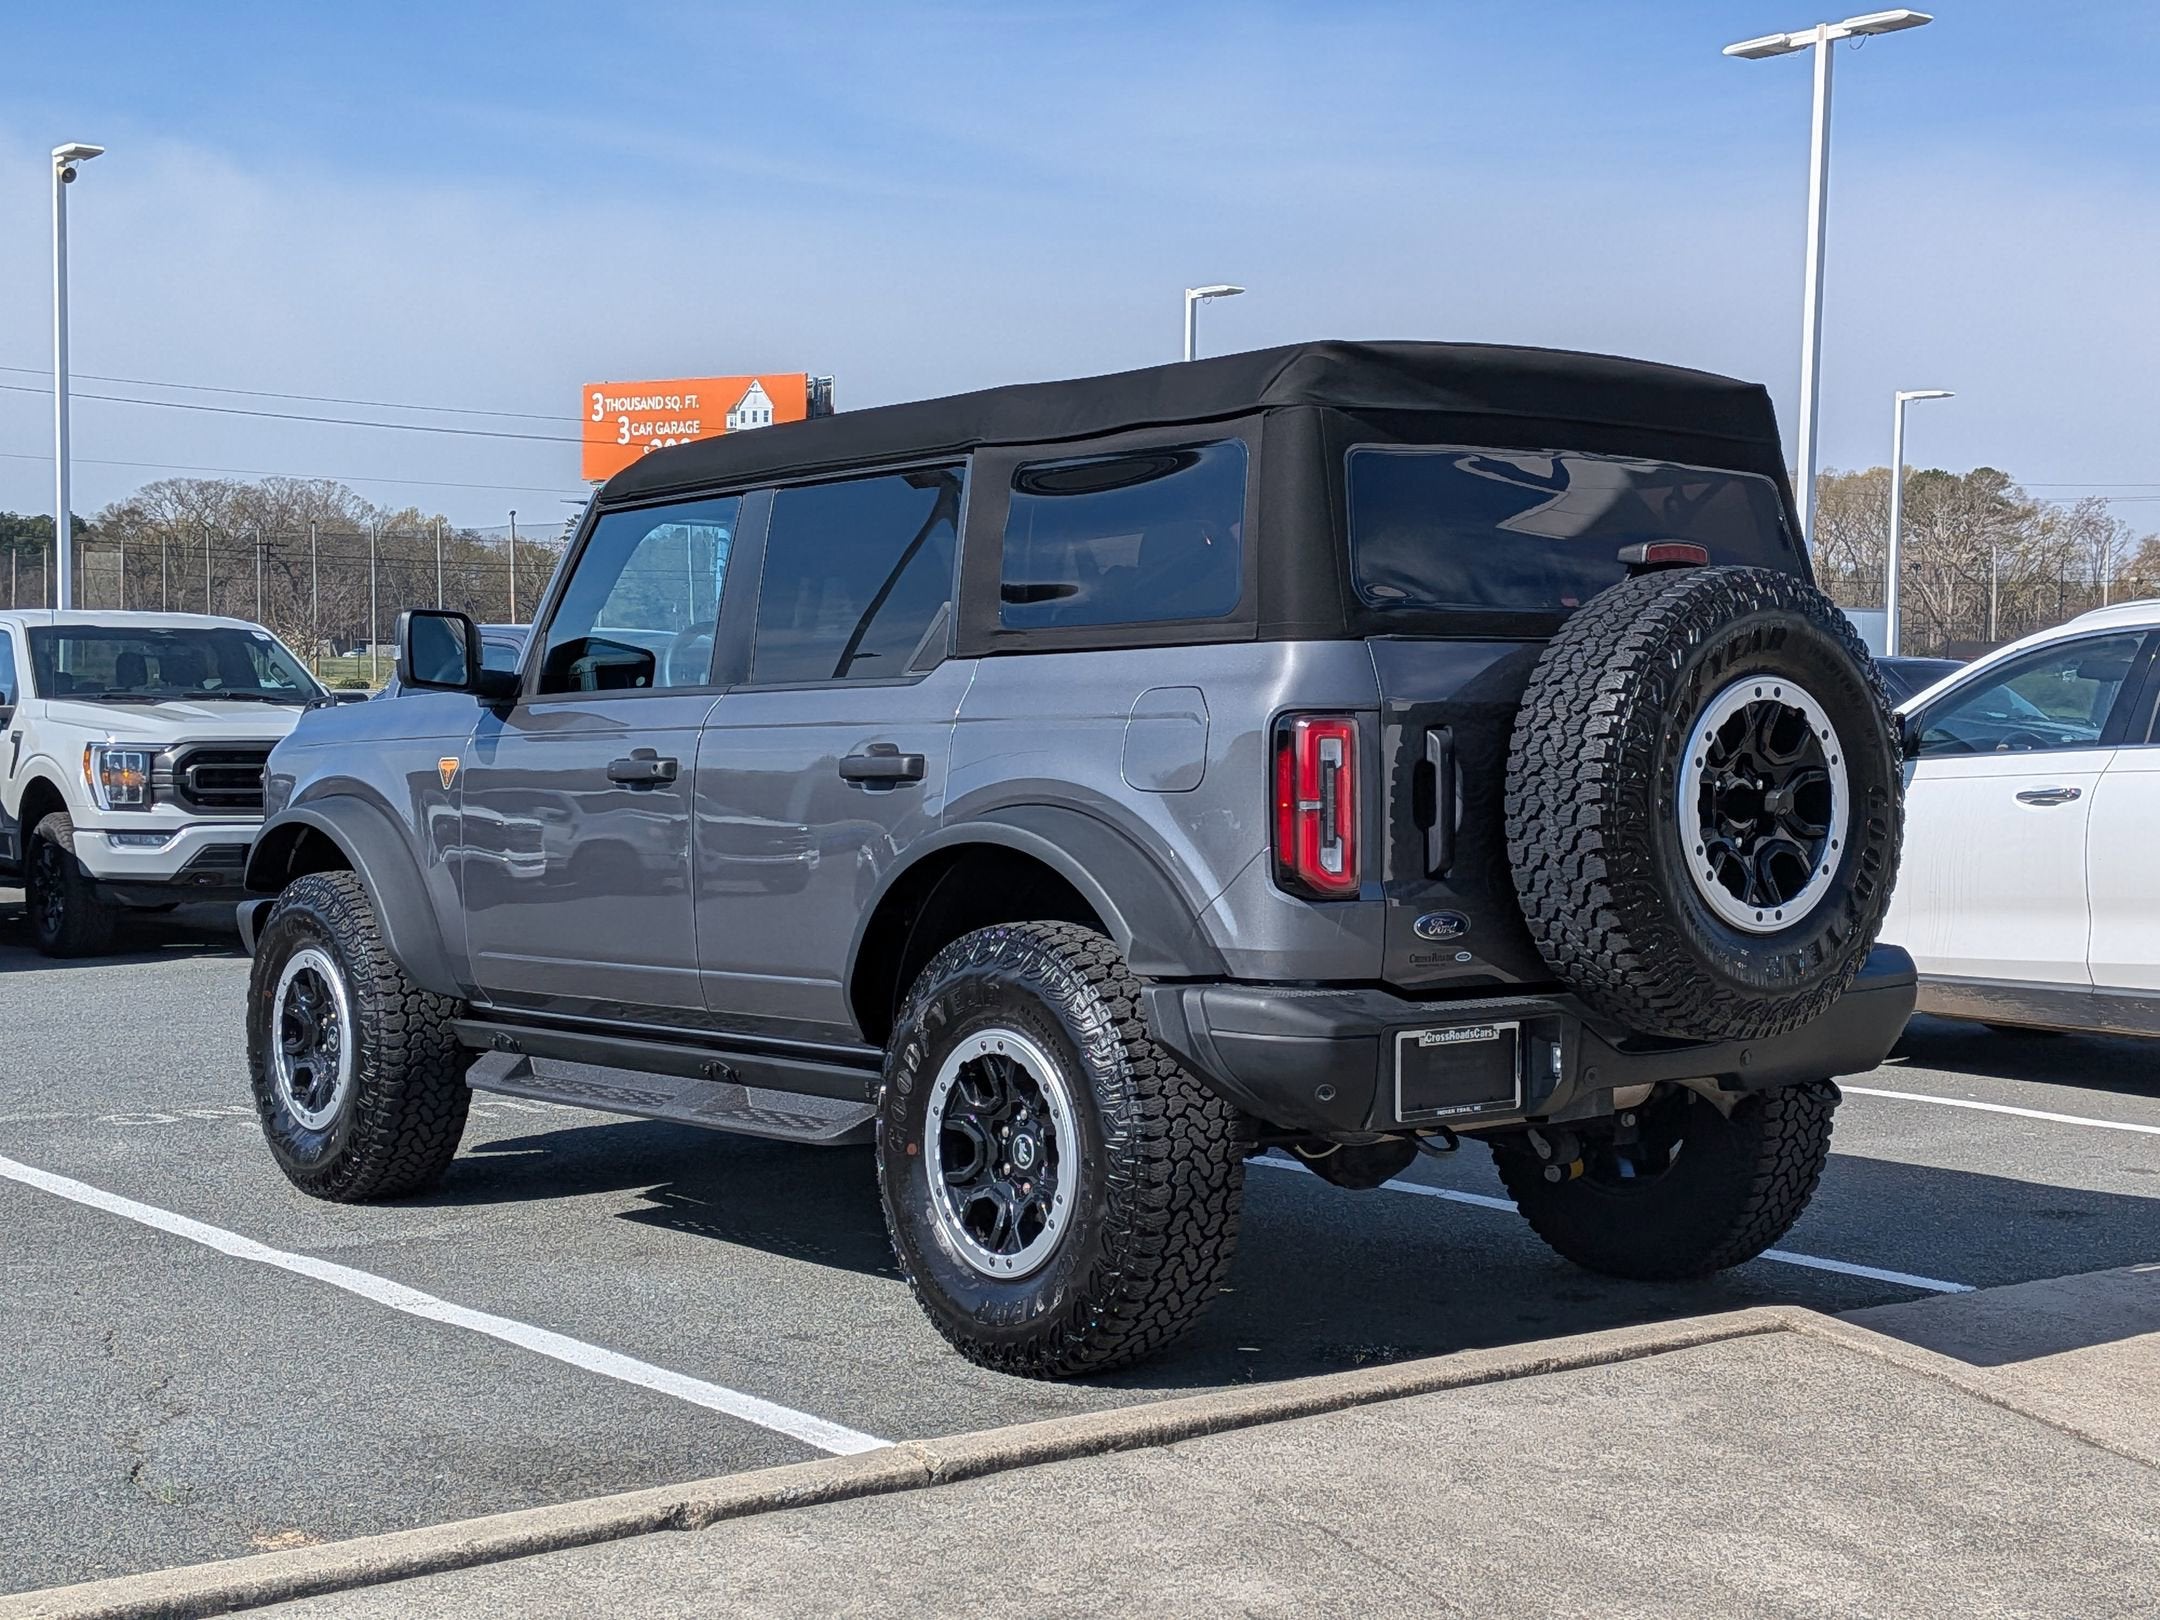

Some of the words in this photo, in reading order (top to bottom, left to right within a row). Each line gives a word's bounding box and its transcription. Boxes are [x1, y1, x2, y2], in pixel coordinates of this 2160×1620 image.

[591, 392, 604, 422] 3
[604, 396, 664, 412] THOUSAND
[665, 395, 683, 412] SQ.
[685, 394, 700, 409] FT.
[617, 415, 631, 445] 3
[631, 422, 653, 436] CAR
[655, 420, 700, 435] GARAGE
